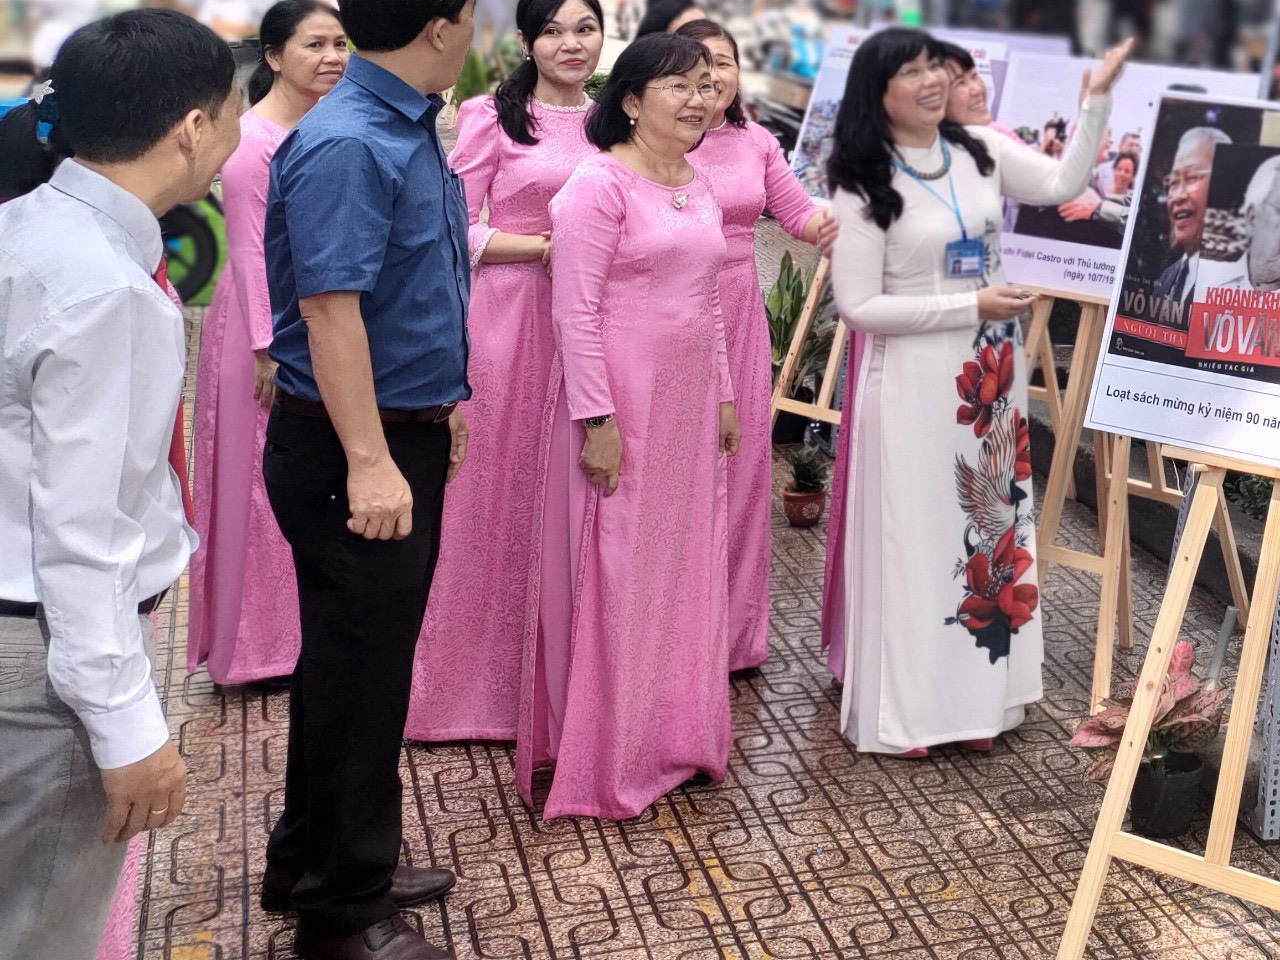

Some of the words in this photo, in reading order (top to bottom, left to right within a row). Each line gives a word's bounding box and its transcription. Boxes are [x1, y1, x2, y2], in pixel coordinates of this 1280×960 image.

[1036, 251, 1062, 264] Castro
[1063, 256, 1076, 265] với
[1077, 258, 1092, 268] Thủ
[1093, 262, 1116, 274] tướng
[1063, 268, 1086, 281] (ngày
[1087, 272, 1116, 285] 10/7/19
[1124, 289, 1146, 315] VÕ
[1149, 294, 1185, 325] VĂN
[1203, 309, 1235, 353] VÕ
[1106, 385, 1131, 402] Loạt
[1132, 391, 1160, 406] sách
[1162, 398, 1195, 415] mừng
[1198, 401, 1212, 418] kỷ
[1214, 407, 1243, 423] niệm
[1245, 412, 1260, 425] 90
